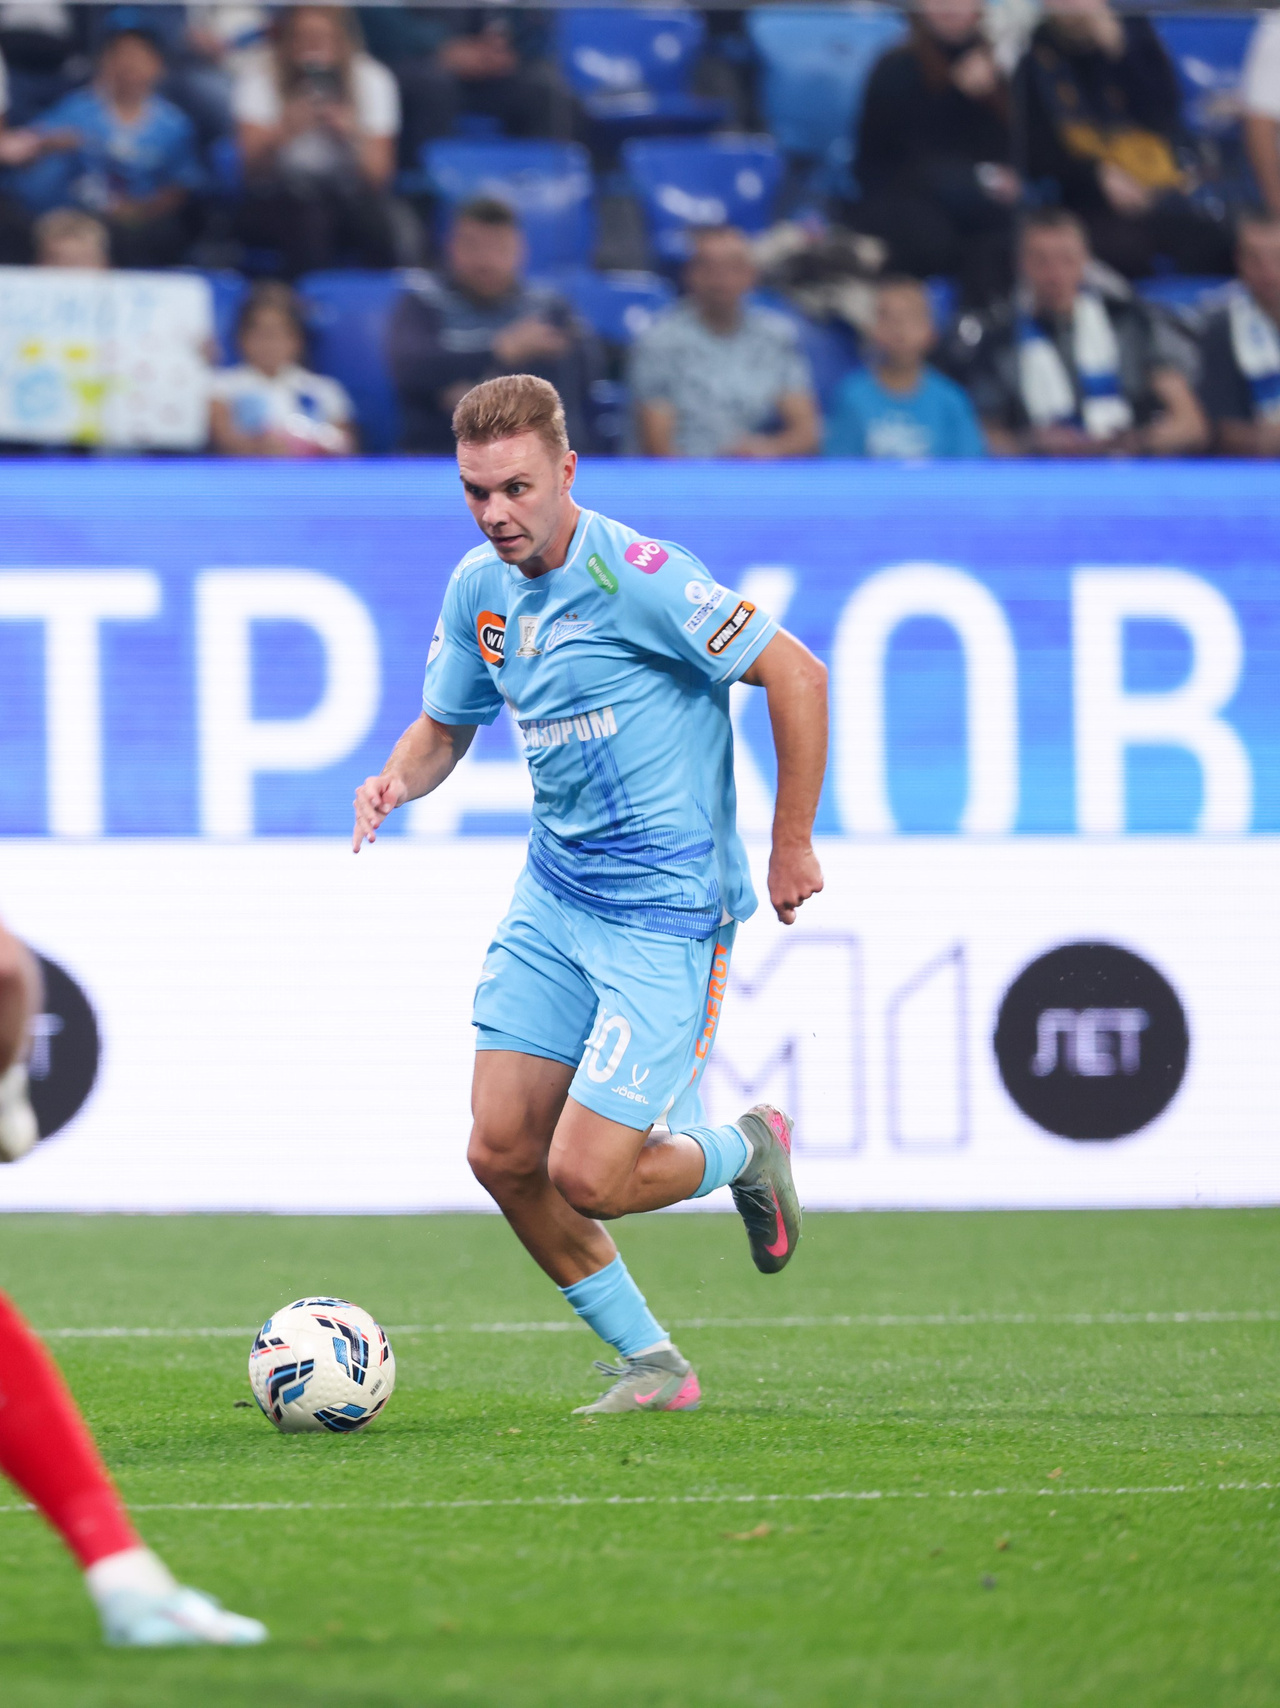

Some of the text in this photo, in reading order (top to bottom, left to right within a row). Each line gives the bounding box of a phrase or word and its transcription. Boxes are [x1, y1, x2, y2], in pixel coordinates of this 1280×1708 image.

[632, 542, 661, 568] wb
[709, 606, 750, 652] WINLINE
[1028, 1007, 1150, 1078] ЛЕТ
[611, 1085, 649, 1105] JÖGEL
